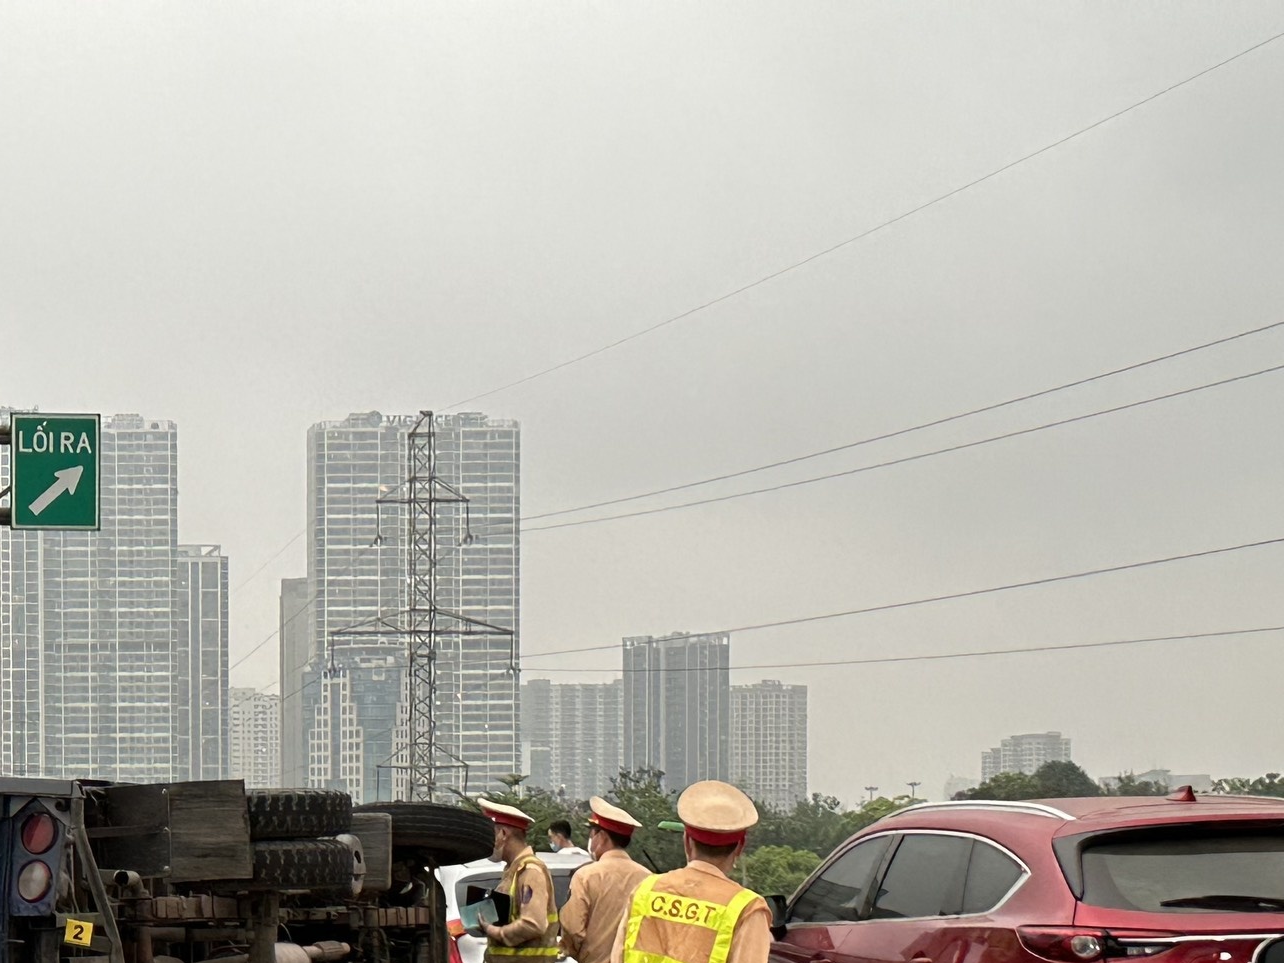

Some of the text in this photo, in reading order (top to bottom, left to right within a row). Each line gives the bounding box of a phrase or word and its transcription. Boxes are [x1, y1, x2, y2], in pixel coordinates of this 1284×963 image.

[18, 420, 92, 454] LỐI RA
[72, 924, 85, 941] 2
